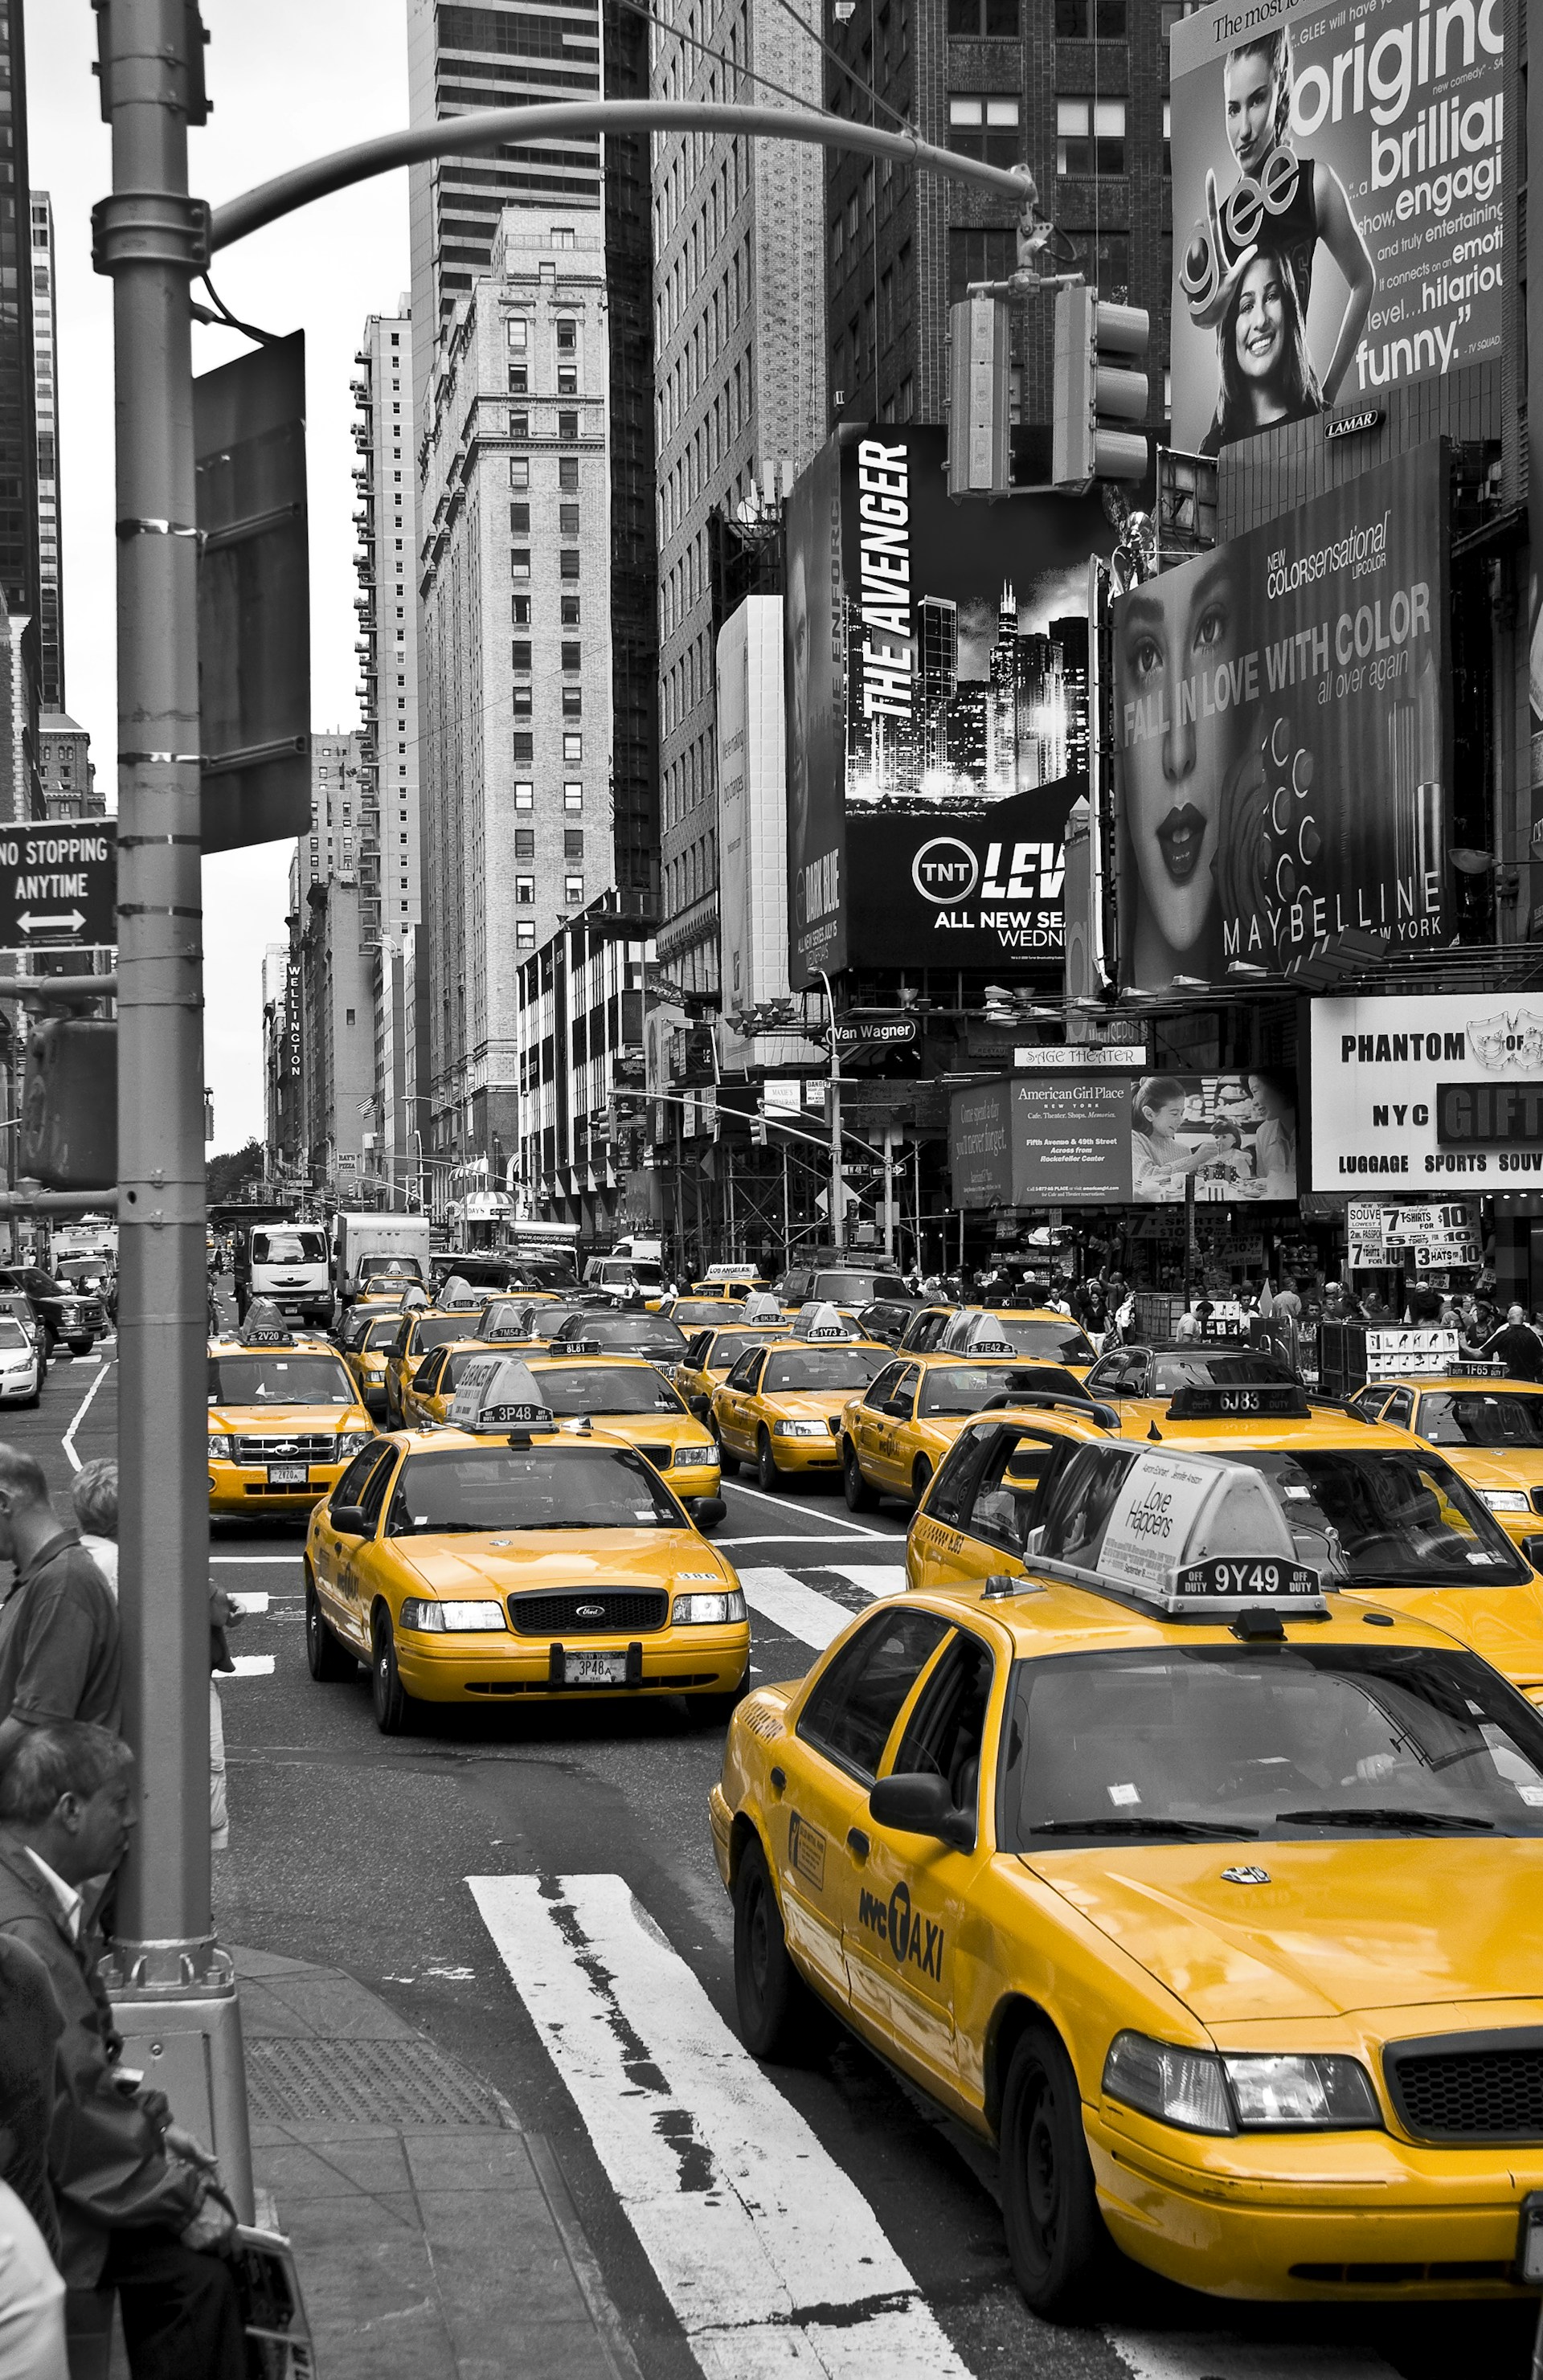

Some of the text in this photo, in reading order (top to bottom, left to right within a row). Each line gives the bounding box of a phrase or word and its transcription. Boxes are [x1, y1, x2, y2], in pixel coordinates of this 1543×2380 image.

[1328, 1, 1377, 31] will have
[1213, 14, 1242, 43] The
[1432, 80, 1449, 96] new
[1179, 145, 1300, 317] glee
[1357, 209, 1396, 236] show,
[1377, 239, 1398, 261] and
[1401, 233, 1423, 252] truly
[1386, 261, 1430, 289] connects
[1431, 262, 1442, 273] on
[1442, 258, 1452, 268] an
[1328, 412, 1373, 437] LAMAR
[1267, 548, 1286, 574] NEW
[1352, 553, 1387, 580] LIPCOLOR
[857, 440, 913, 719] THE AVENGER
[1124, 582, 1430, 748] FALL IN LOVE WITH COLOR
[1317, 650, 1408, 705] all over again
[26, 836, 108, 865] STOPPING
[922, 863, 969, 881] TNT
[15, 873, 89, 900] ANYTIME
[805, 848, 840, 923] DARK BLUE
[934, 911, 1066, 929] ALL NEW SE
[1223, 870, 1441, 956] MAYBELLINE
[997, 930, 1067, 947] WEDN
[1398, 915, 1442, 941] YORK
[288, 966, 301, 1076] WELLINGTON
[835, 1024, 911, 1040] Van Wagner
[1025, 1049, 1136, 1064] SAGE THEATER
[1341, 1033, 1525, 1063] PHANTOM OF
[1017, 1086, 1124, 1100] American Girl Place
[1373, 1104, 1429, 1127] NYC
[1445, 1089, 1543, 1139] GIFT
[1339, 1155, 1409, 1174] LUGGAGE
[1424, 1154, 1487, 1172] SPORTS
[1130, 1214, 1147, 1236] 7
[1382, 1209, 1400, 1232] 7
[1438, 1205, 1467, 1228] $10
[1385, 1235, 1406, 1245] 5
[1352, 1243, 1363, 1266] 7
[1417, 1247, 1430, 1266] 3
[1430, 1250, 1452, 1262] HATS
[258, 1331, 280, 1341] 2V20
[499, 1328, 519, 1336] 7M54
[819, 1328, 837, 1337] 1Y73
[566, 1343, 585, 1354] 8L81
[980, 1343, 1001, 1352] 7E42
[1466, 1364, 1488, 1376] 1F65
[1219, 1391, 1261, 1411] 6J83
[498, 1406, 531, 1421] 3P48
[1144, 1482, 1173, 1513] Love
[1125, 1499, 1173, 1541] Happens
[1185, 1582, 1207, 1593] DUTY
[1188, 1571, 1203, 1581] OFF
[1214, 1564, 1279, 1593] 9Y49
[1289, 1581, 1312, 1593] DUTY
[1292, 1571, 1308, 1582] OFF
[582, 1607, 599, 1616] Ford
[858, 1880, 944, 1983] NYC TAXI
